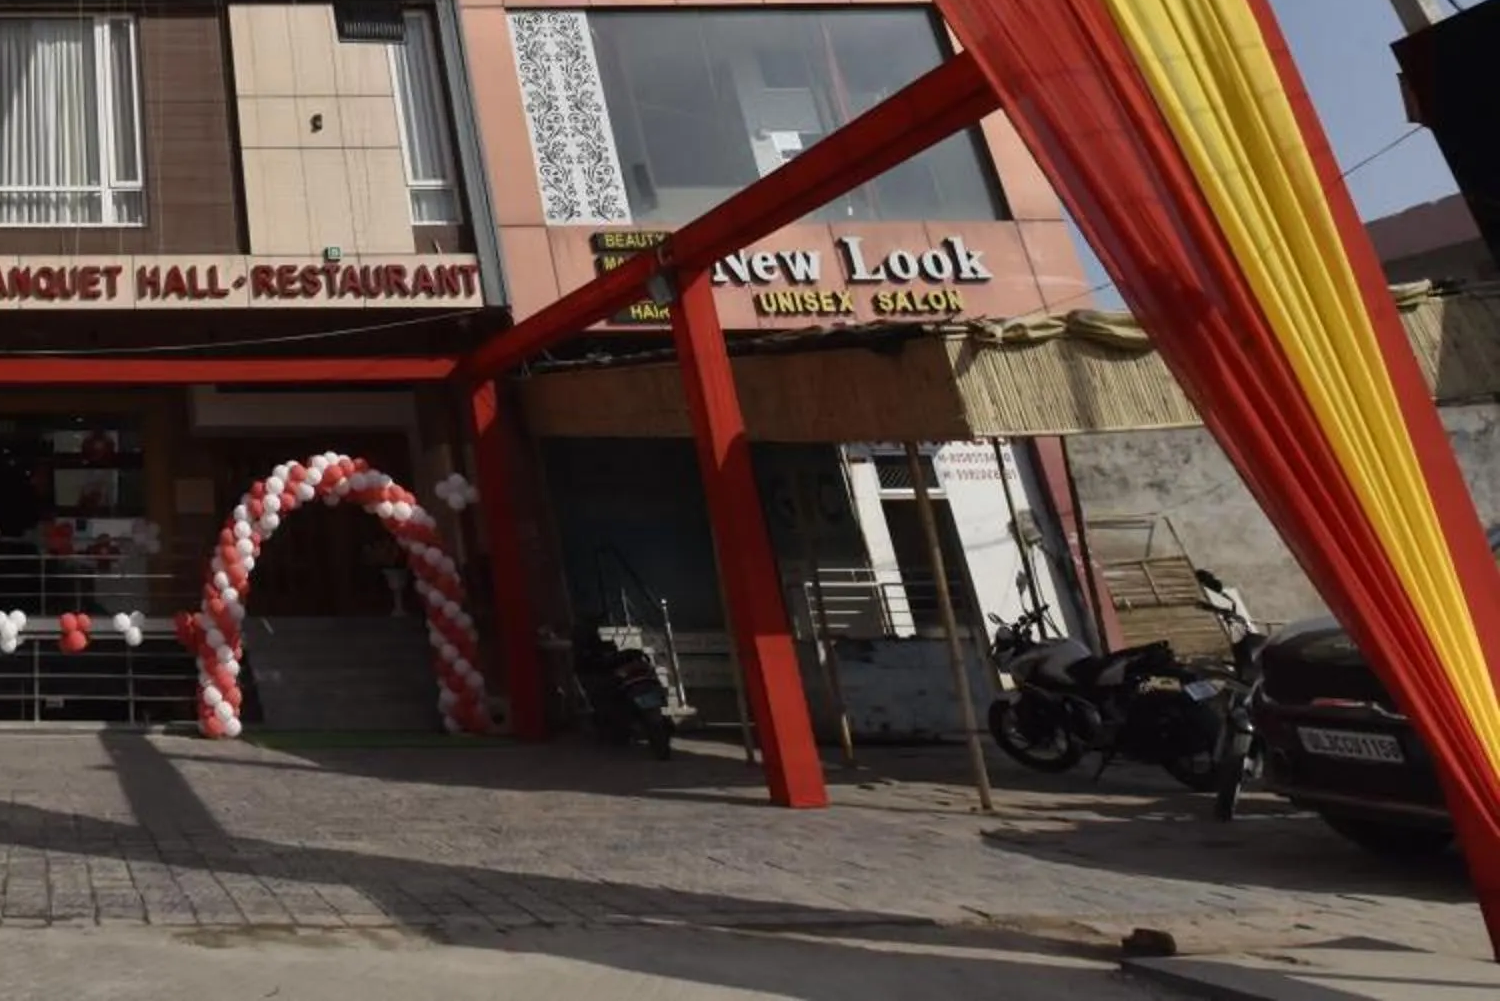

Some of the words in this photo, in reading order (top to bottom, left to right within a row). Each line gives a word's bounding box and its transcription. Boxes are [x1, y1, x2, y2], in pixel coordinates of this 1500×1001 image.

[604, 233, 666, 248] BEAUTY
[713, 249, 821, 283] New
[838, 235, 994, 283] Look
[135, 264, 229, 299] HALL
[249, 263, 479, 299] RESTAURANT
[759, 290, 853, 314] UNISEX
[877, 289, 966, 314] SALON
